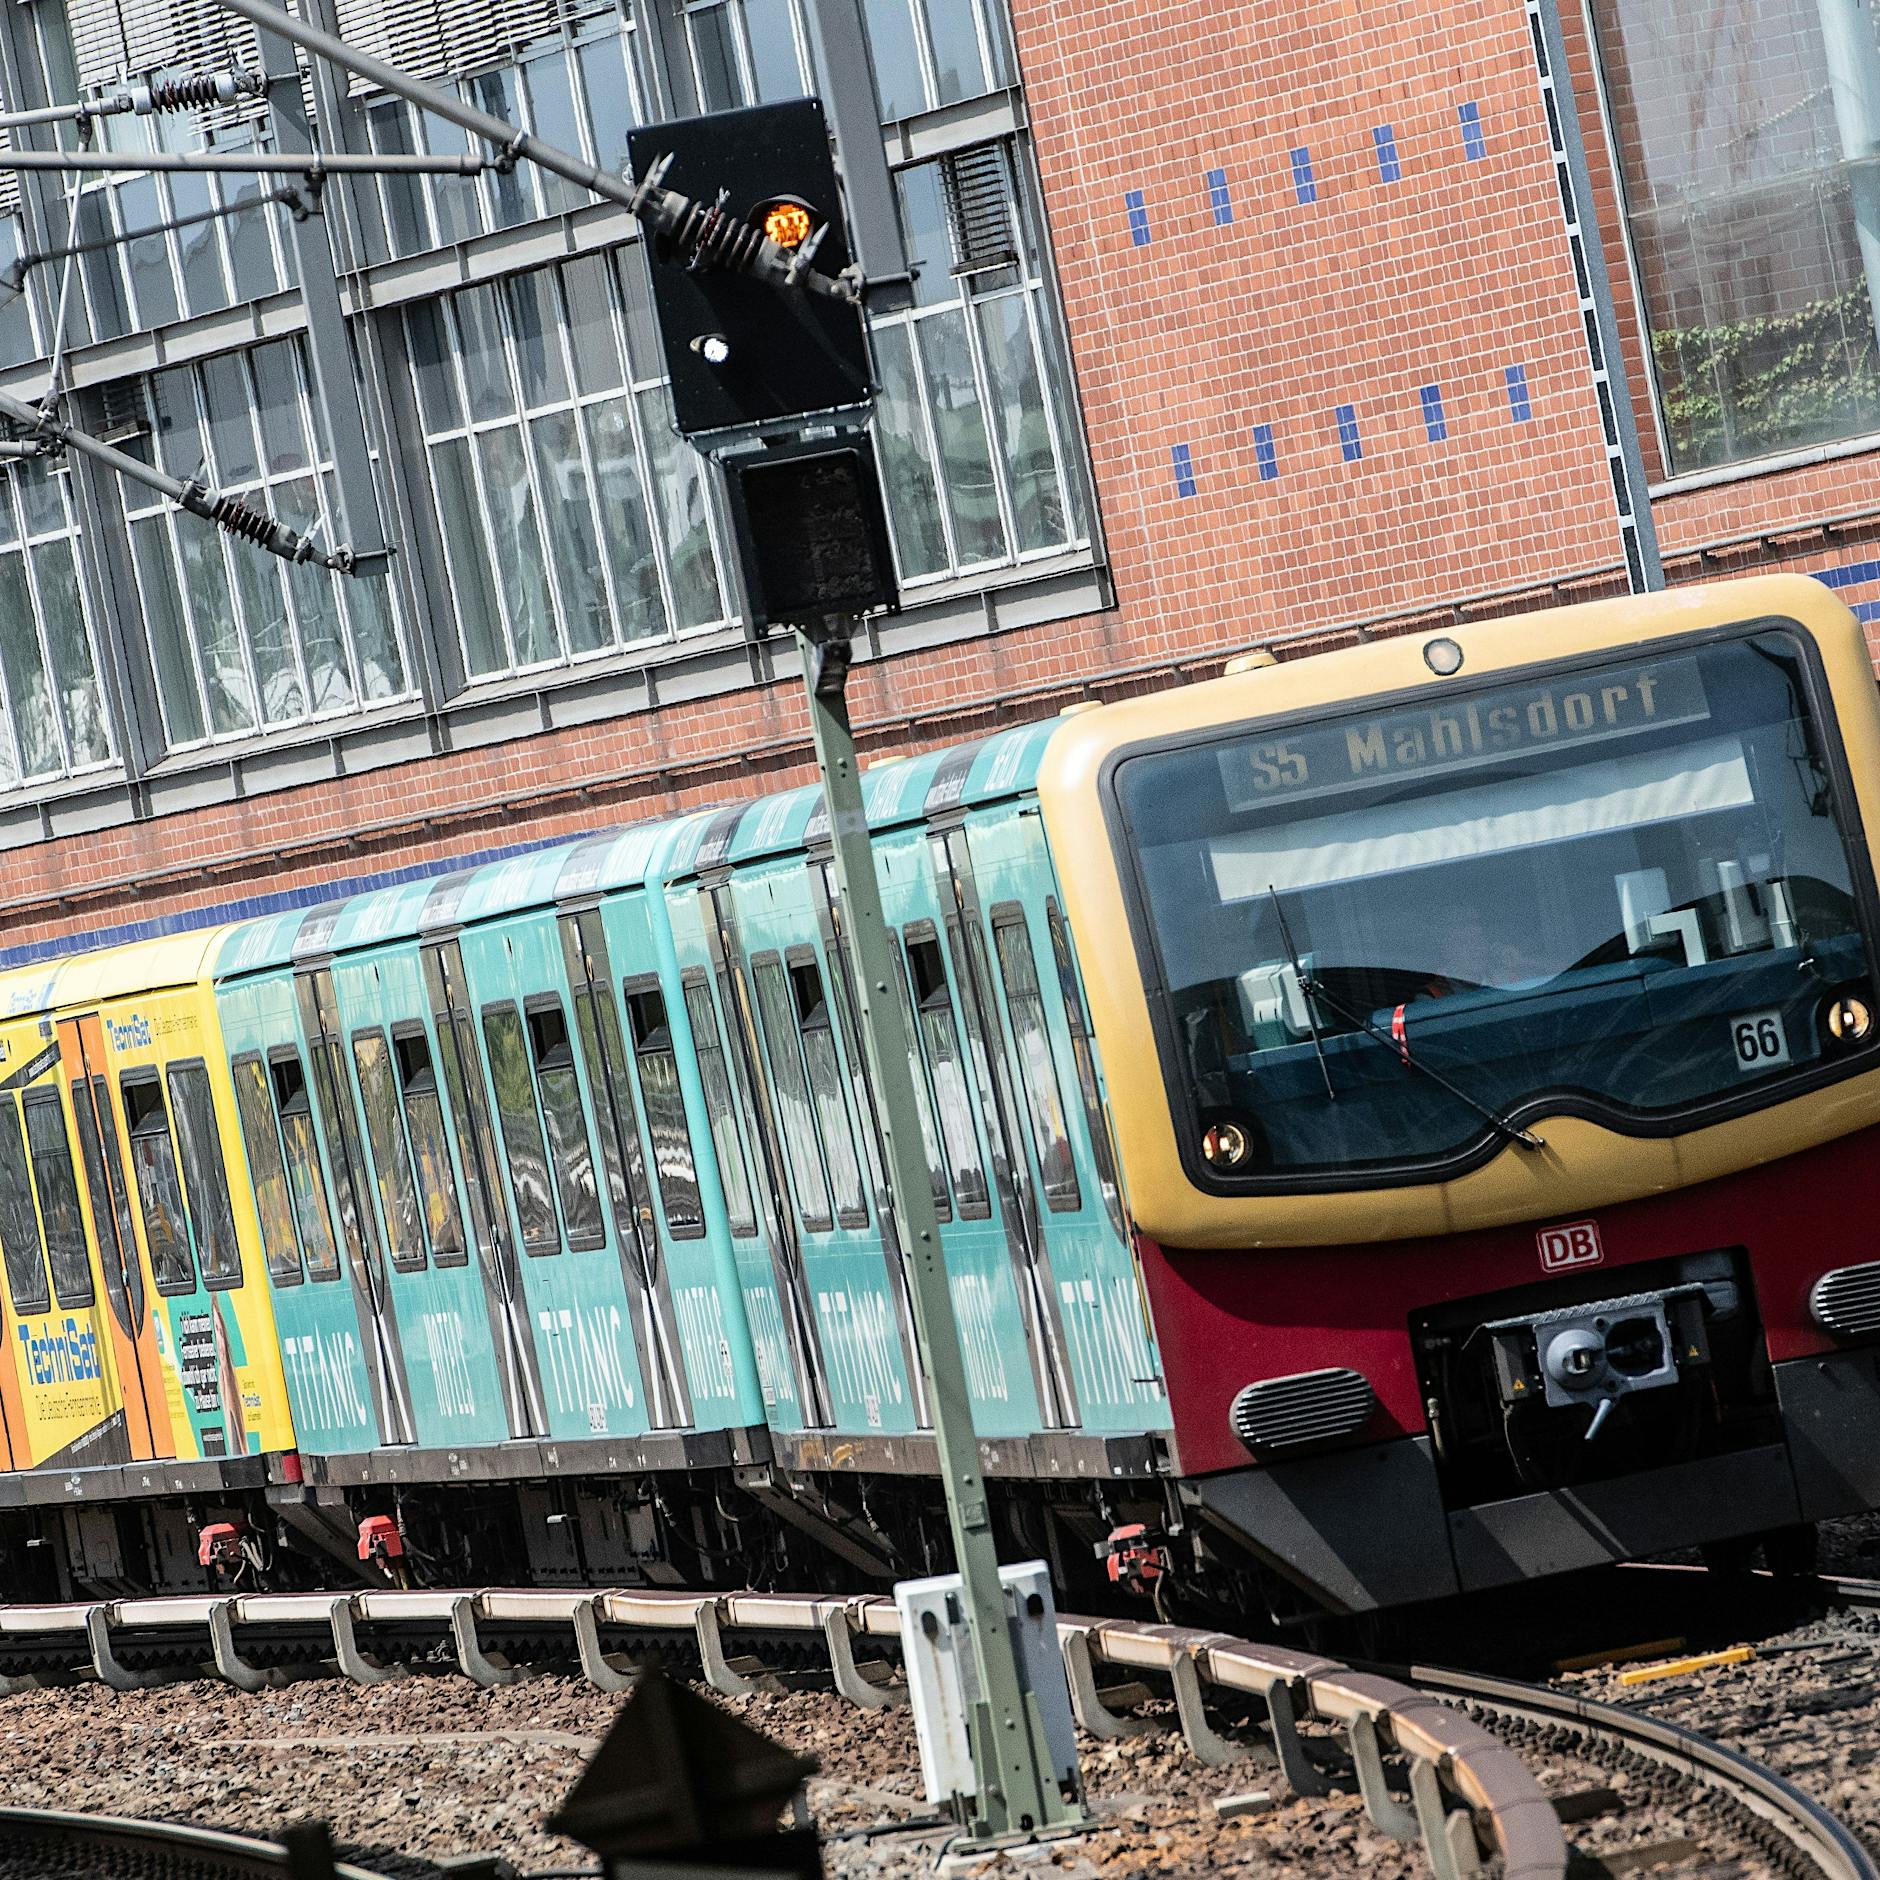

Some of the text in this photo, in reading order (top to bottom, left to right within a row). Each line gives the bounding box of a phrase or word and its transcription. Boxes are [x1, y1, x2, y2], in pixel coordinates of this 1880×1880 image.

[1249, 671, 1659, 791] S5 Mahlsdorf
[106, 1013, 152, 1052] TechniSat
[1735, 1017, 1780, 1062] 66
[1545, 1229, 1594, 1265] DB
[18, 1317, 100, 1386] TechniSat
[285, 1311, 475, 1431] TITANIC HOTELS
[538, 1286, 735, 1413] TITANIC HOTELS
[818, 1280, 901, 1404] TITANIC
